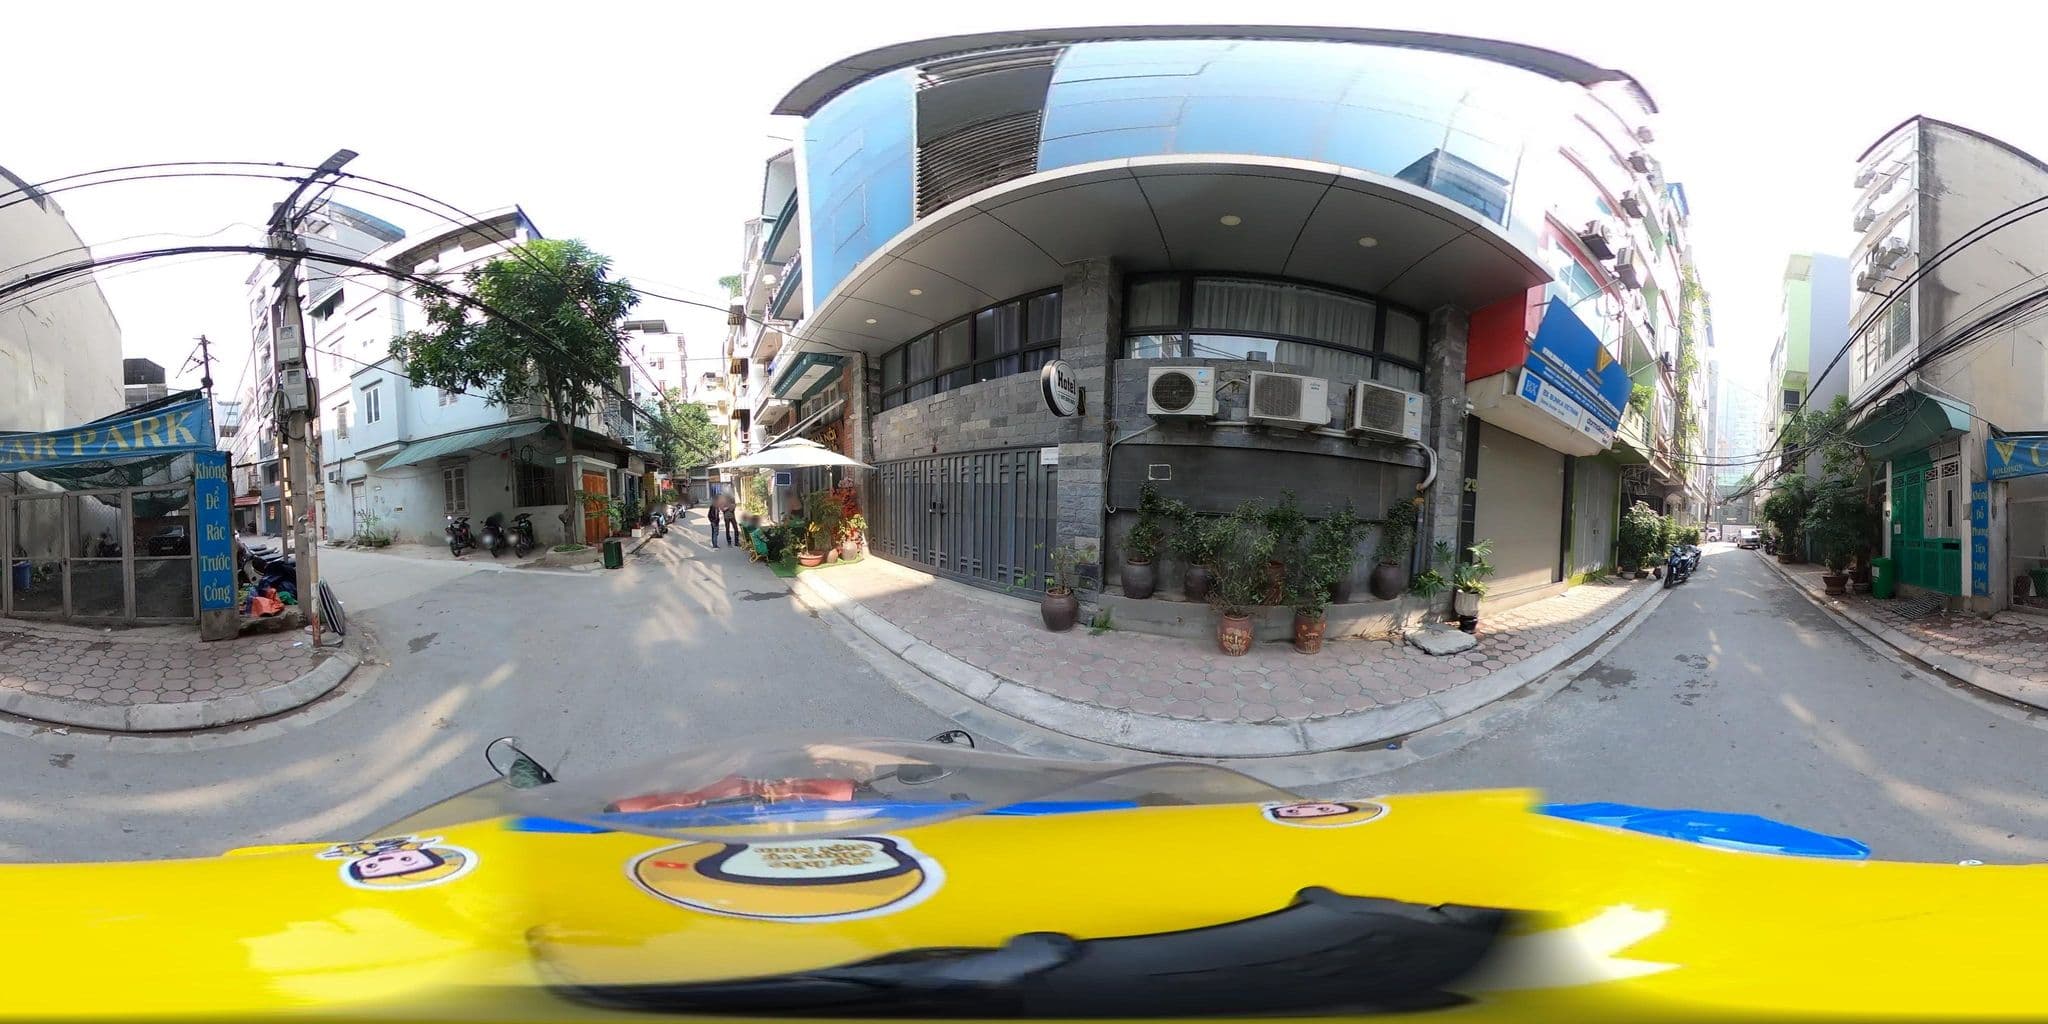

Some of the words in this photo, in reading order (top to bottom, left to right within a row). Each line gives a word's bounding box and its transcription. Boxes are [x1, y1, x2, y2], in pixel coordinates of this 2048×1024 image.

[1057, 370, 1076, 395] Hotel
[72, 411, 198, 457] PARK
[195, 461, 227, 483] Không
[1464, 477, 1478, 492] 29
[206, 486, 220, 510] Để
[207, 520, 225, 541] Rác
[200, 553, 231, 572] Trước
[204, 578, 231, 604] Cổng
